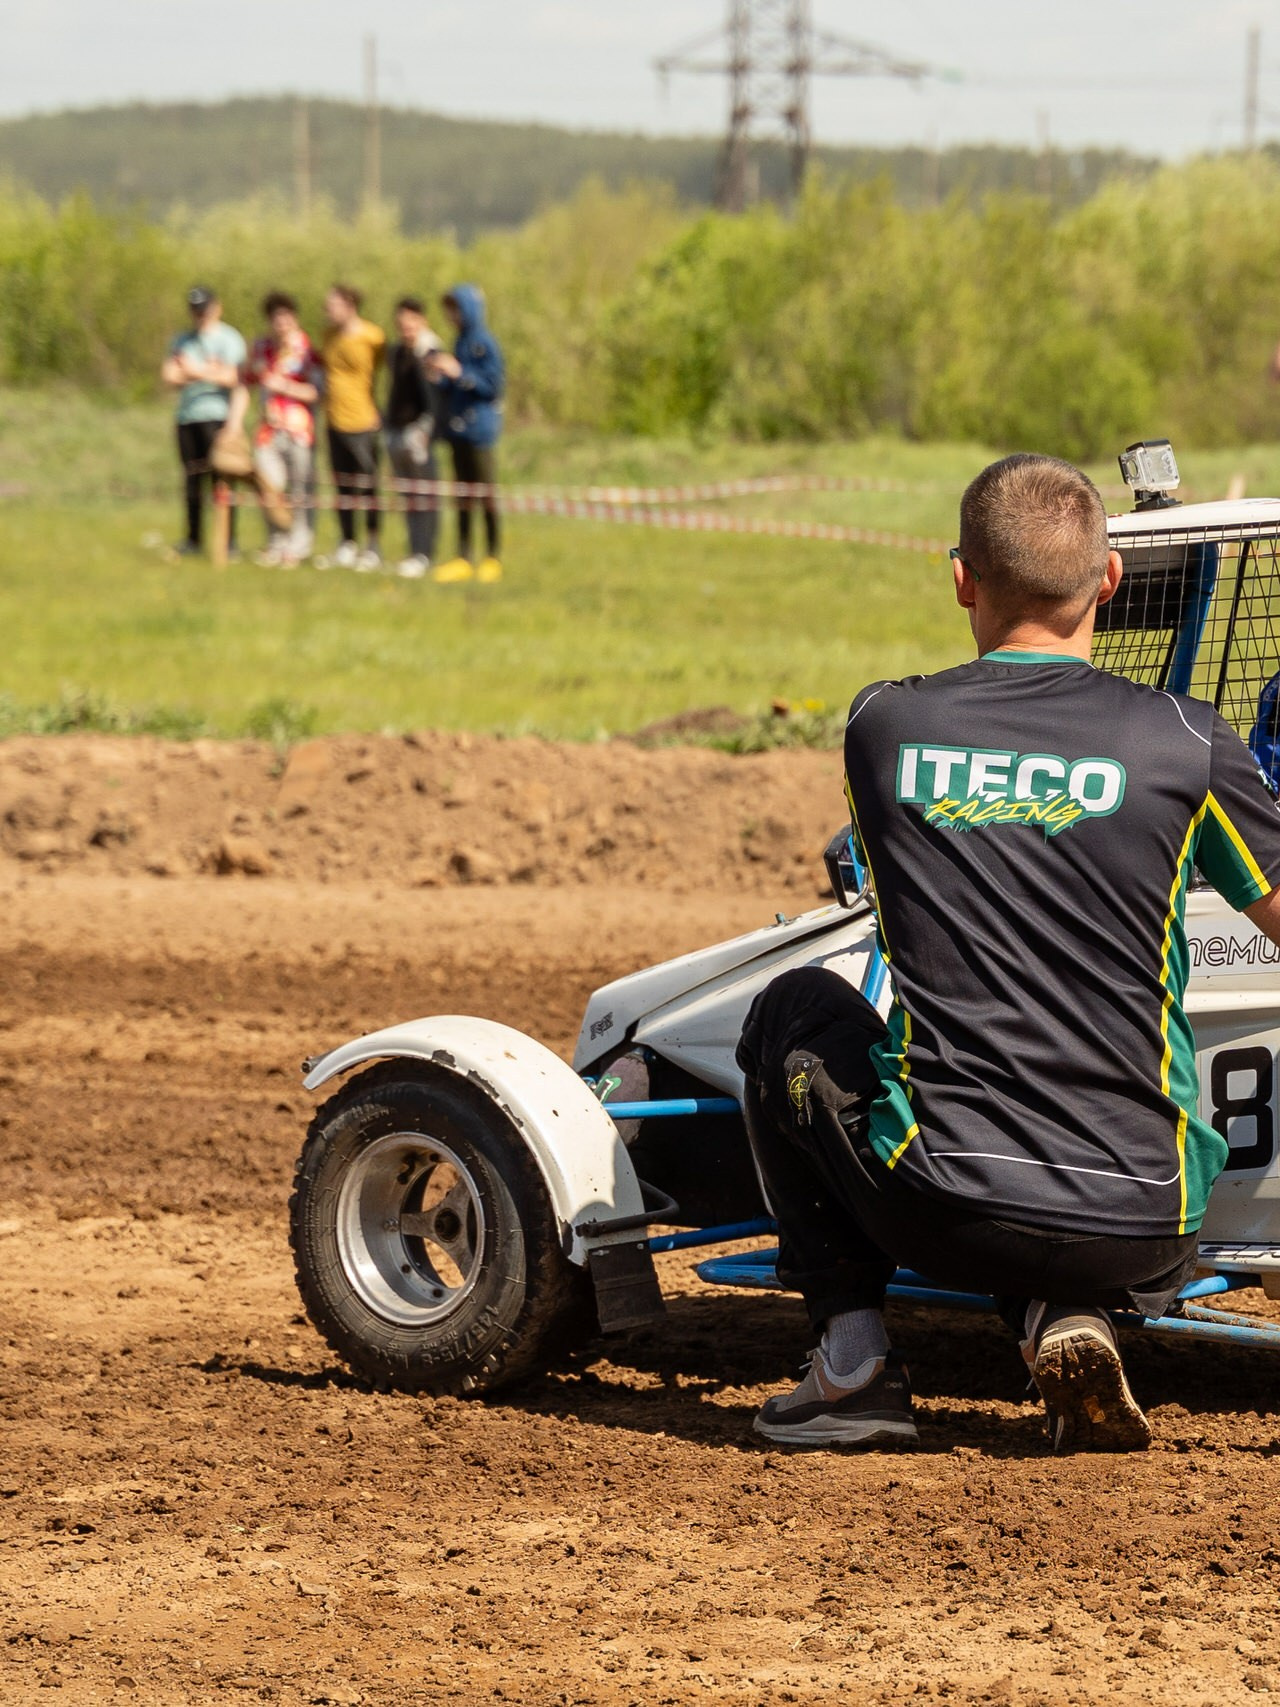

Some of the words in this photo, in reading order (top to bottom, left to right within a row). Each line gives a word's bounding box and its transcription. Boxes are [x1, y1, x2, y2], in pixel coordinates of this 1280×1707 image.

[900, 748, 1123, 813] ITECO
[925, 795, 1083, 833] RACING
[1211, 1046, 1273, 1171] 8
